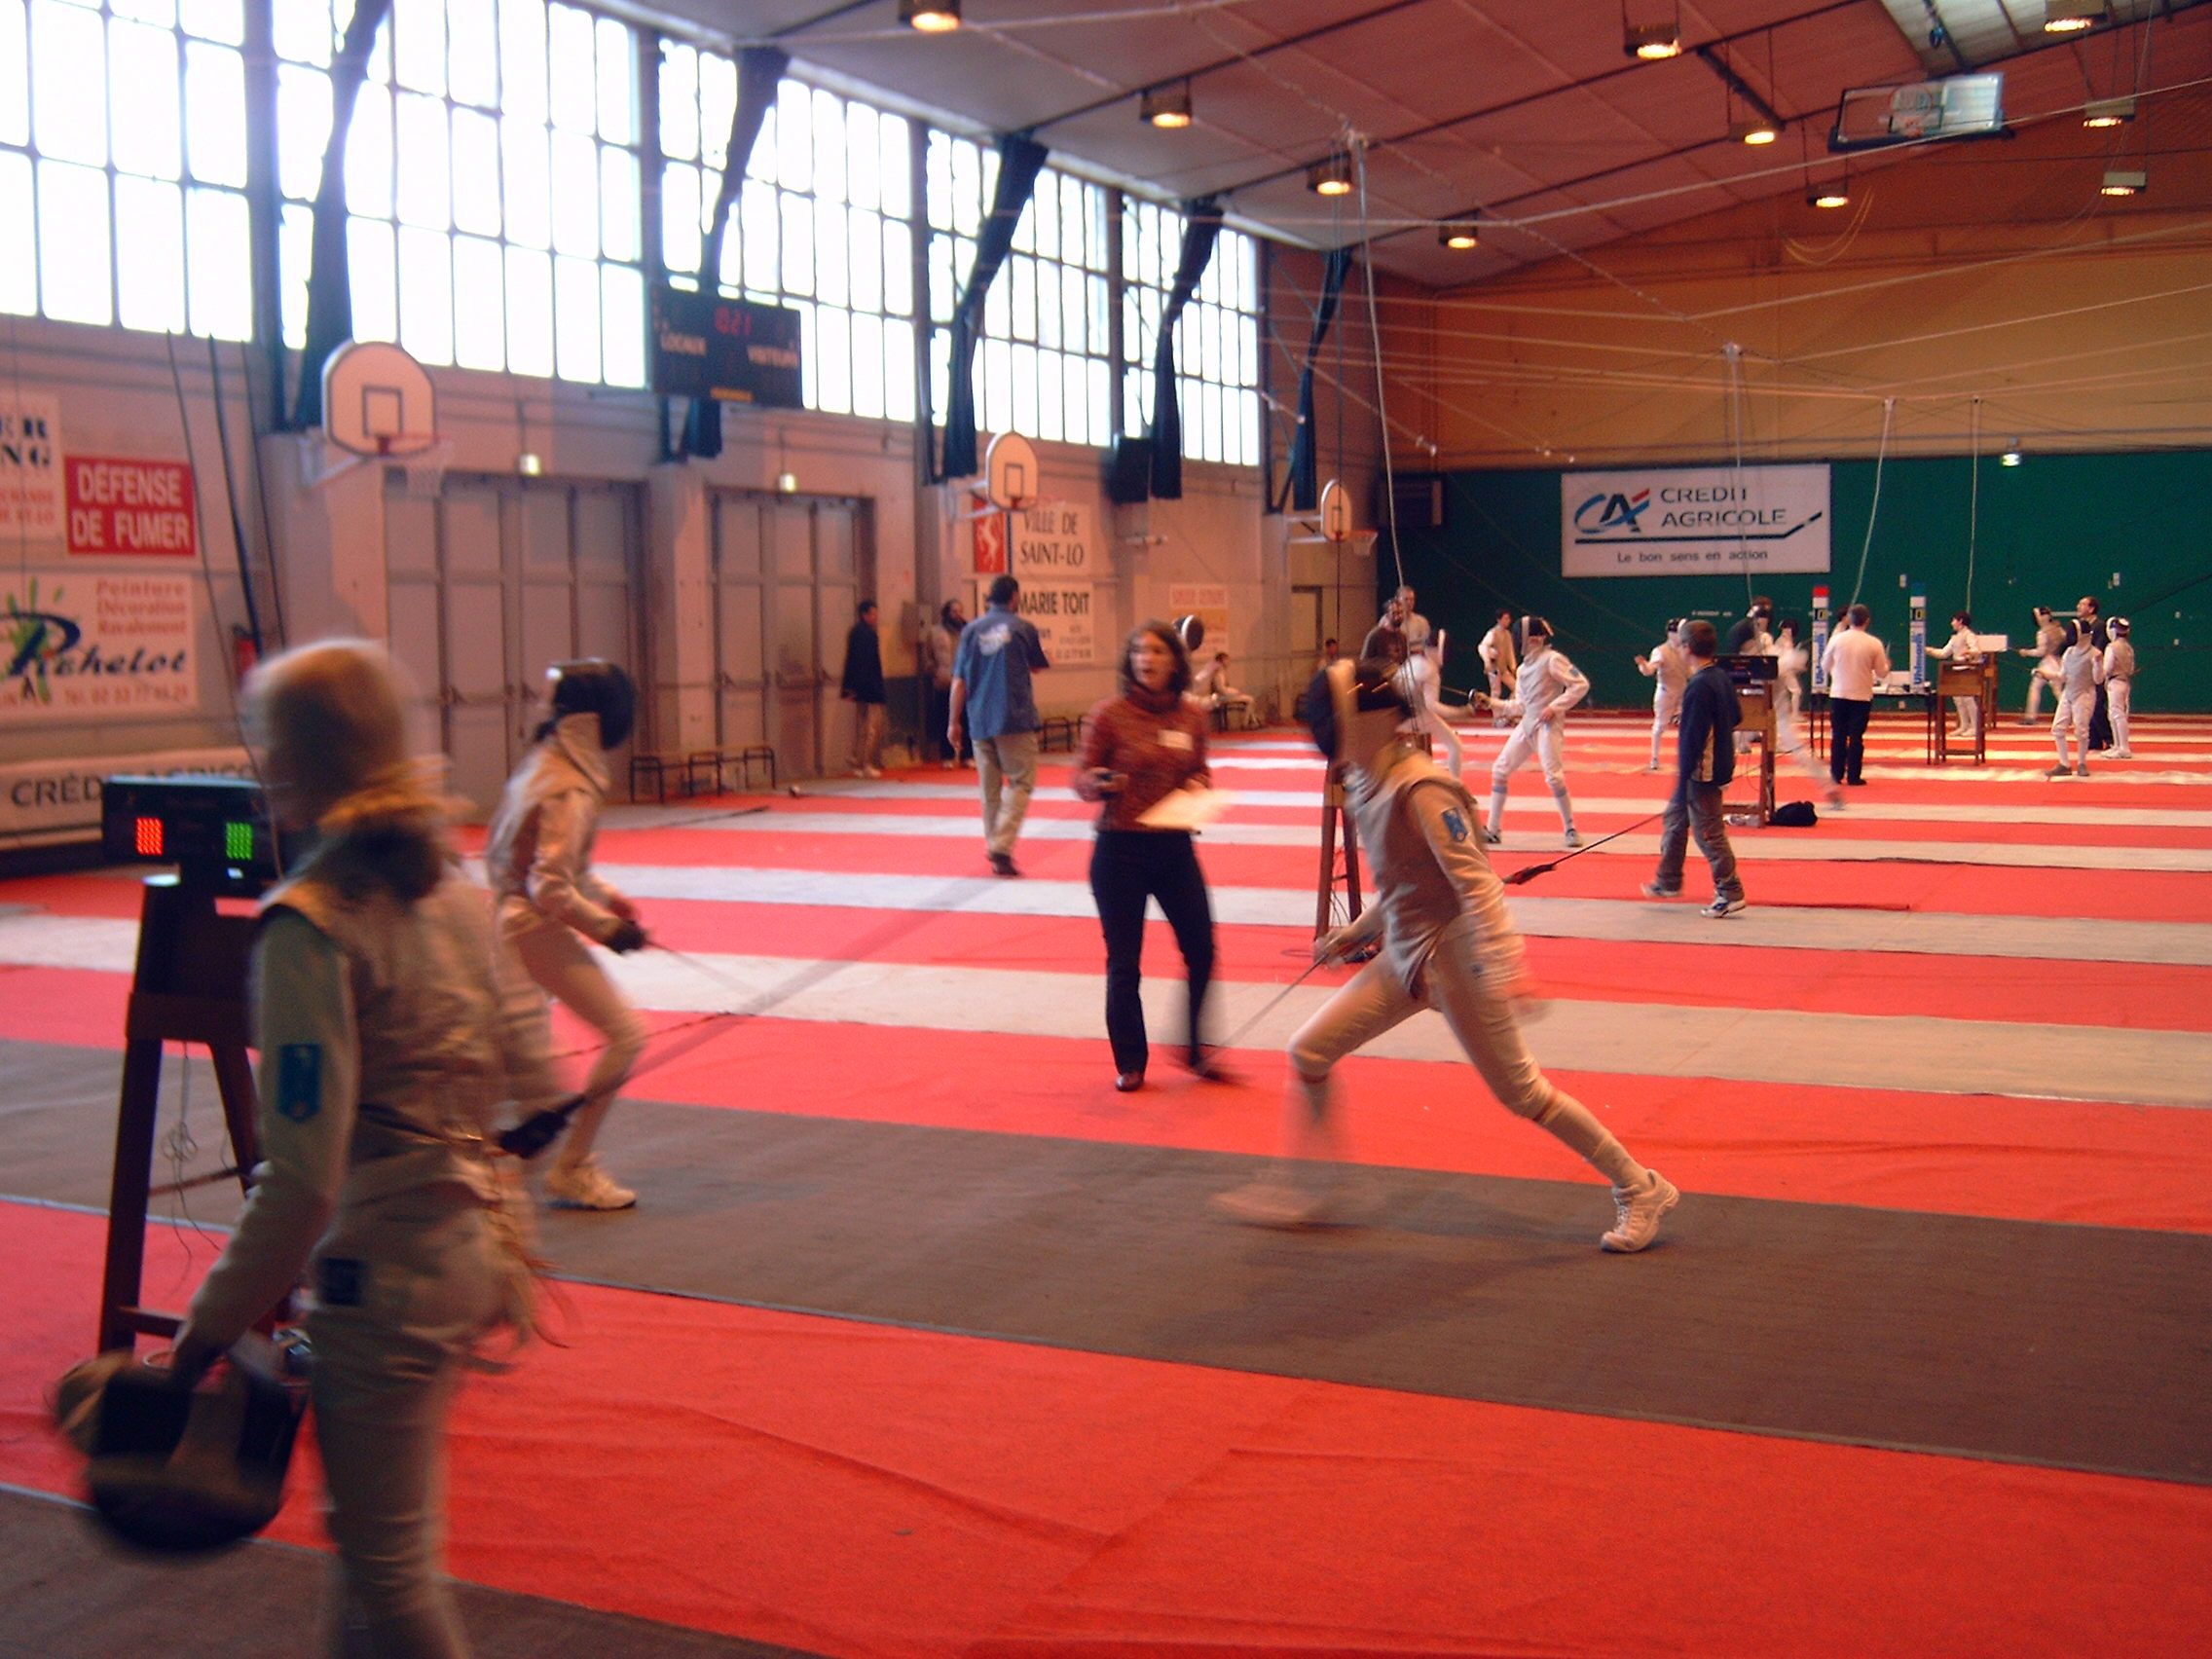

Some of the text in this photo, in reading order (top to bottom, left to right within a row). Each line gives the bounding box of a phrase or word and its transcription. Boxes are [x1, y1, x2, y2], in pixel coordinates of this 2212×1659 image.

[71, 509, 103, 548] DE
[114, 510, 190, 550] FUMER
[1024, 510, 1077, 535] VILLE DE
[1661, 508, 1788, 529] AGRICOLE
[1617, 548, 1768, 564] Le bon sens en action
[1062, 591, 1089, 615] TOIT
[11, 771, 104, 807] CRÉD
